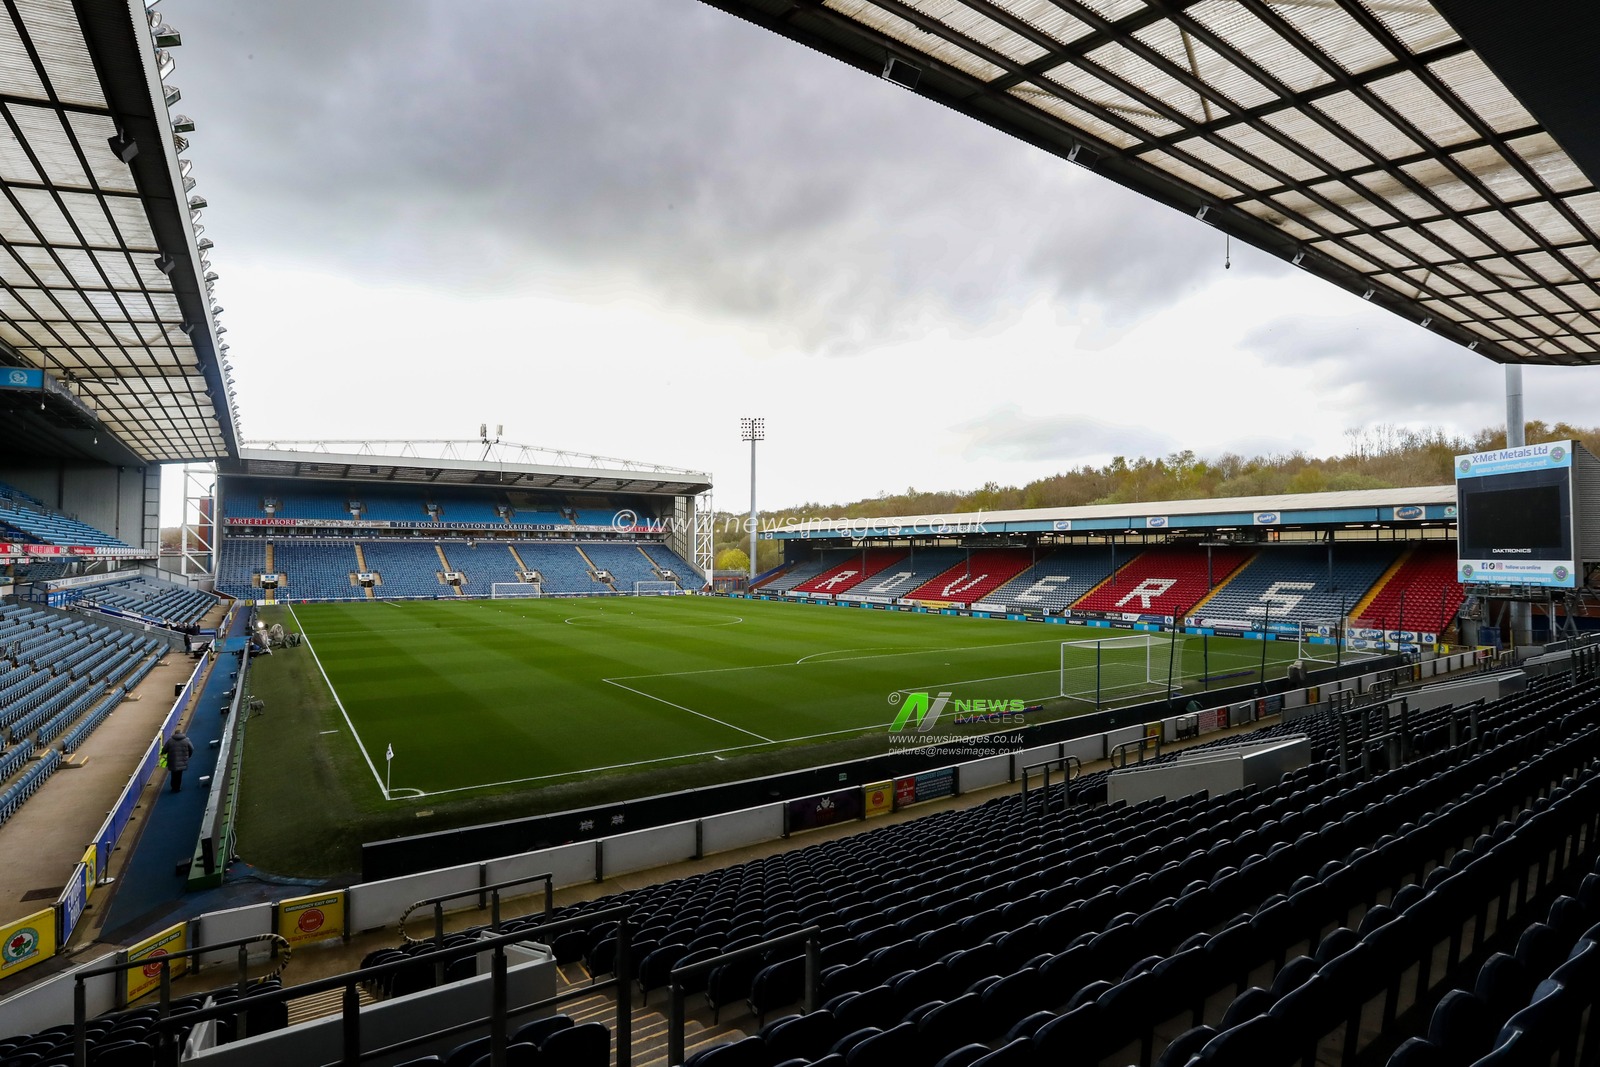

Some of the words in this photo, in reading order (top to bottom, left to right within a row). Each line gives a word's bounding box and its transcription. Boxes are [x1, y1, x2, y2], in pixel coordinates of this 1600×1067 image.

[1500, 449, 1531, 460] Metals
[1534, 446, 1548, 456] Ltd
[285, 903, 314, 912] EMERGENCY
[130, 942, 159, 961] EMERGENCY
[158, 937, 169, 946] EXIT
[169, 931, 181, 941] ONLY
